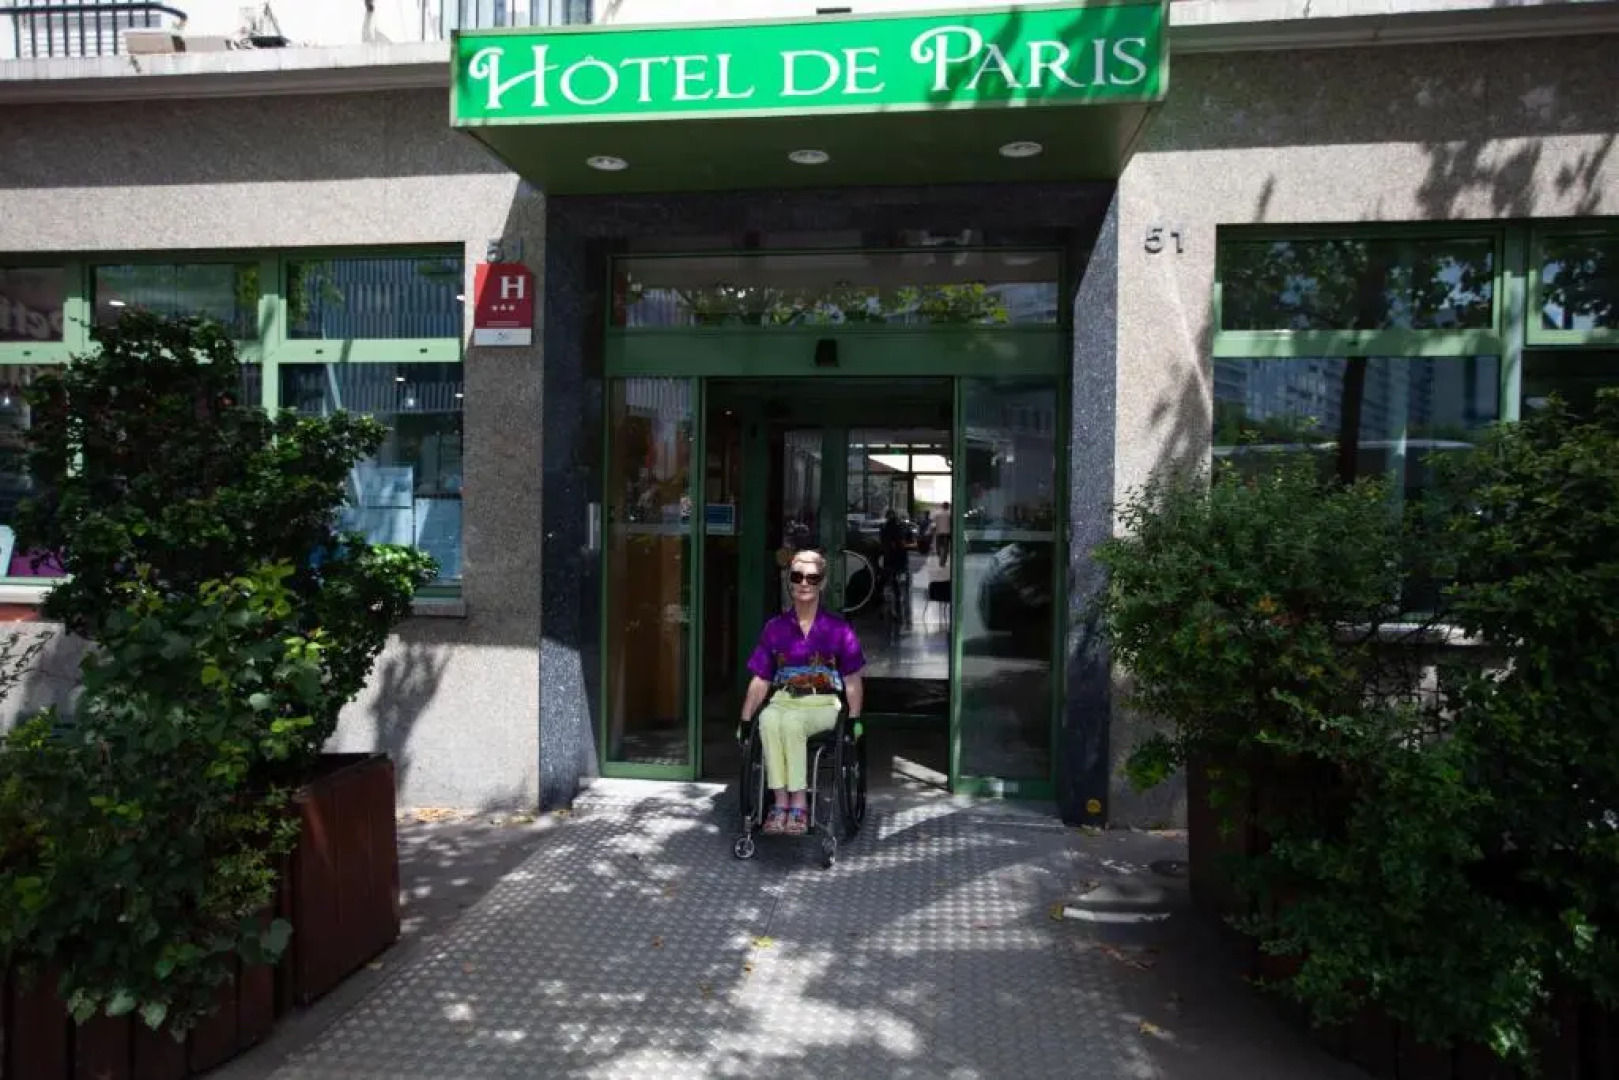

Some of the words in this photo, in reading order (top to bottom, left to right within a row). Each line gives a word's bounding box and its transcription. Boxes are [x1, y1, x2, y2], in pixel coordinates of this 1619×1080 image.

[468, 44, 755, 110] HÔTEL
[780, 47, 886, 97] DE
[910, 25, 1148, 92] PARIS
[1145, 227, 1184, 254] 51
[500, 275, 525, 299] H
